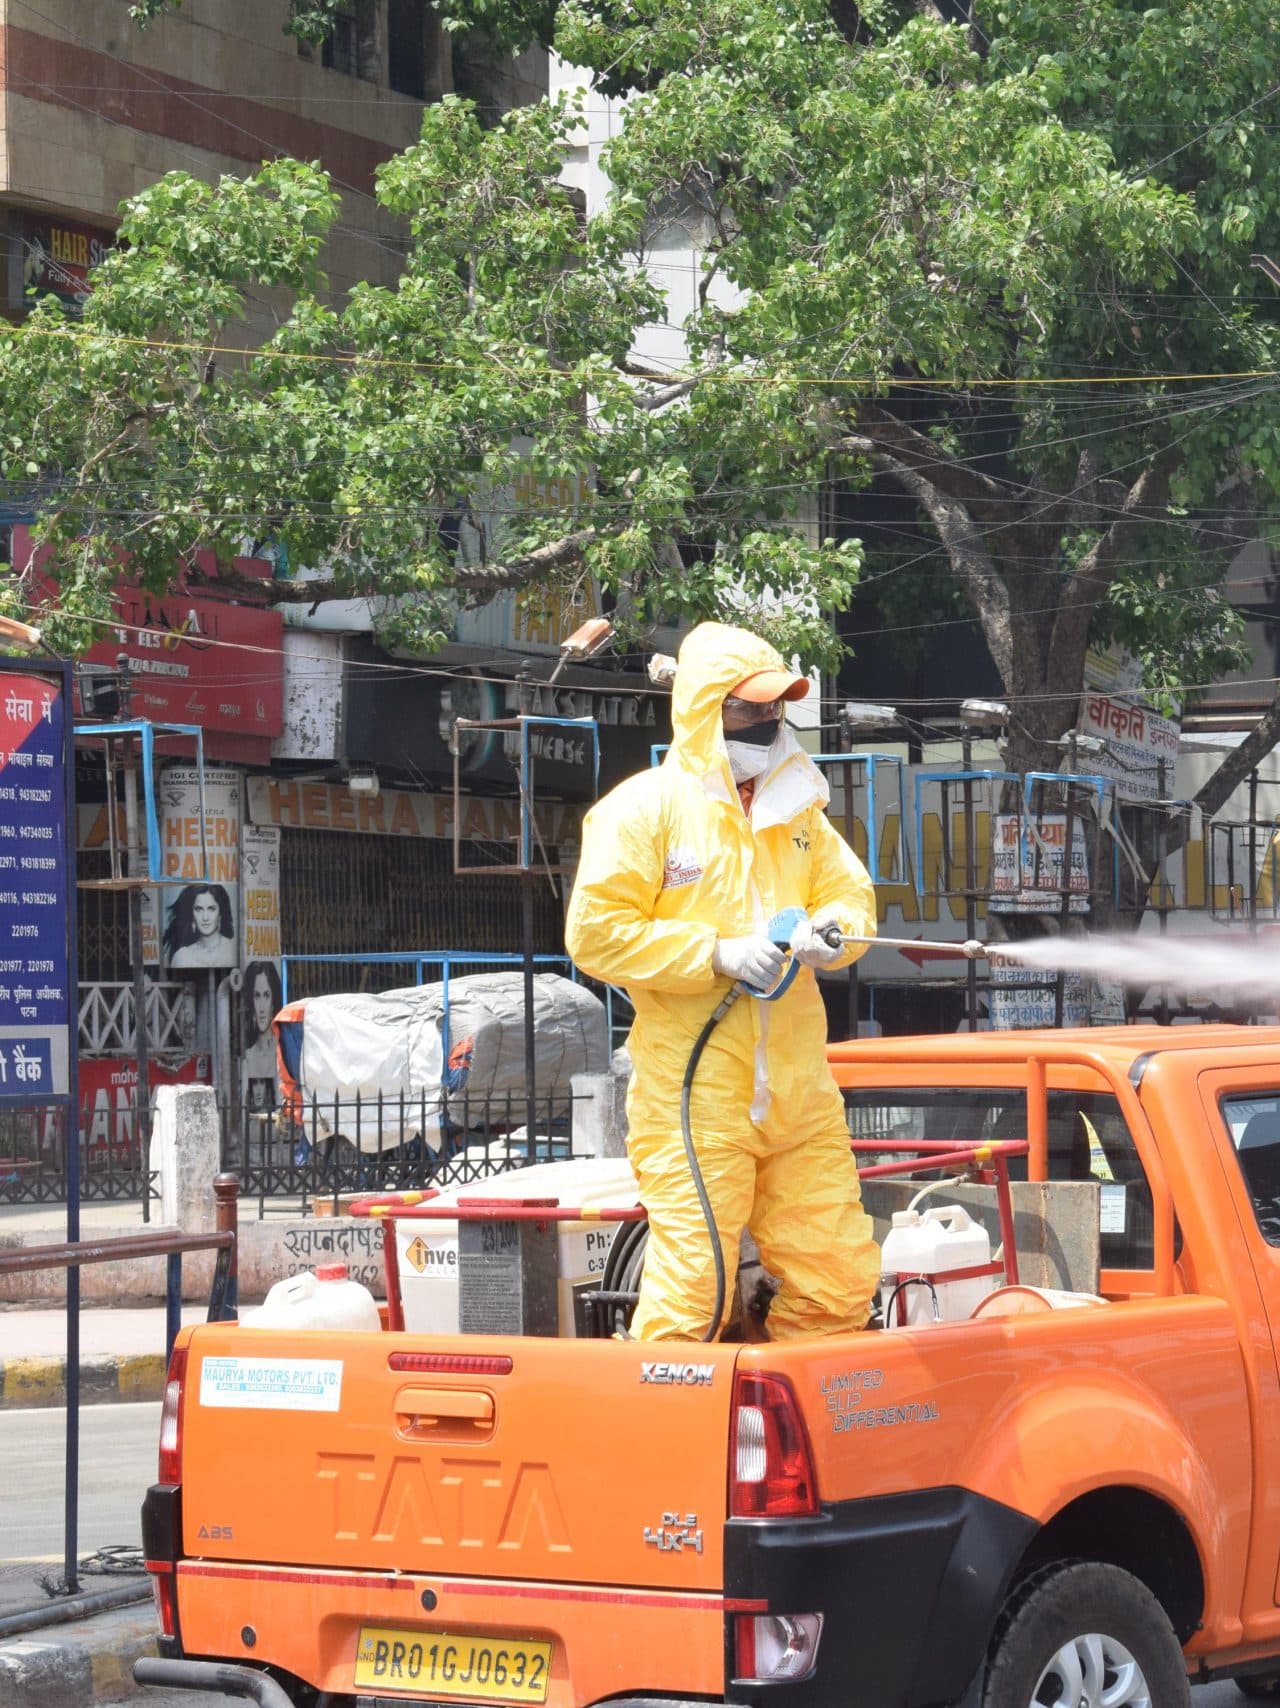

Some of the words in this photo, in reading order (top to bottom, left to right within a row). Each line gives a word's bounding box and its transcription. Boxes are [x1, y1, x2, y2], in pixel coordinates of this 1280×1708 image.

[51, 228, 88, 267] HAIR
[5, 690, 33, 722] सेवा
[41, 691, 52, 724] में
[8, 752, 33, 767] मोबाइल
[269, 782, 421, 836] HEERA
[11, 925, 39, 937] 2201976
[28, 960, 54, 973] 2201978
[20, 1006, 37, 1017] पटना
[13, 1045, 41, 1082] बैंक
[203, 1367, 245, 1381] MAURYA
[247, 1369, 290, 1383] MOTORS
[640, 1361, 716, 1387] XENON
[820, 1369, 884, 1394] LIMITED
[825, 1392, 862, 1413] SLIP
[832, 1401, 940, 1434] DIFFERENTIAL
[316, 1451, 573, 1553] TATA
[197, 1525, 234, 1540] ABS
[374, 1640, 546, 1688] BR01GJ0632
